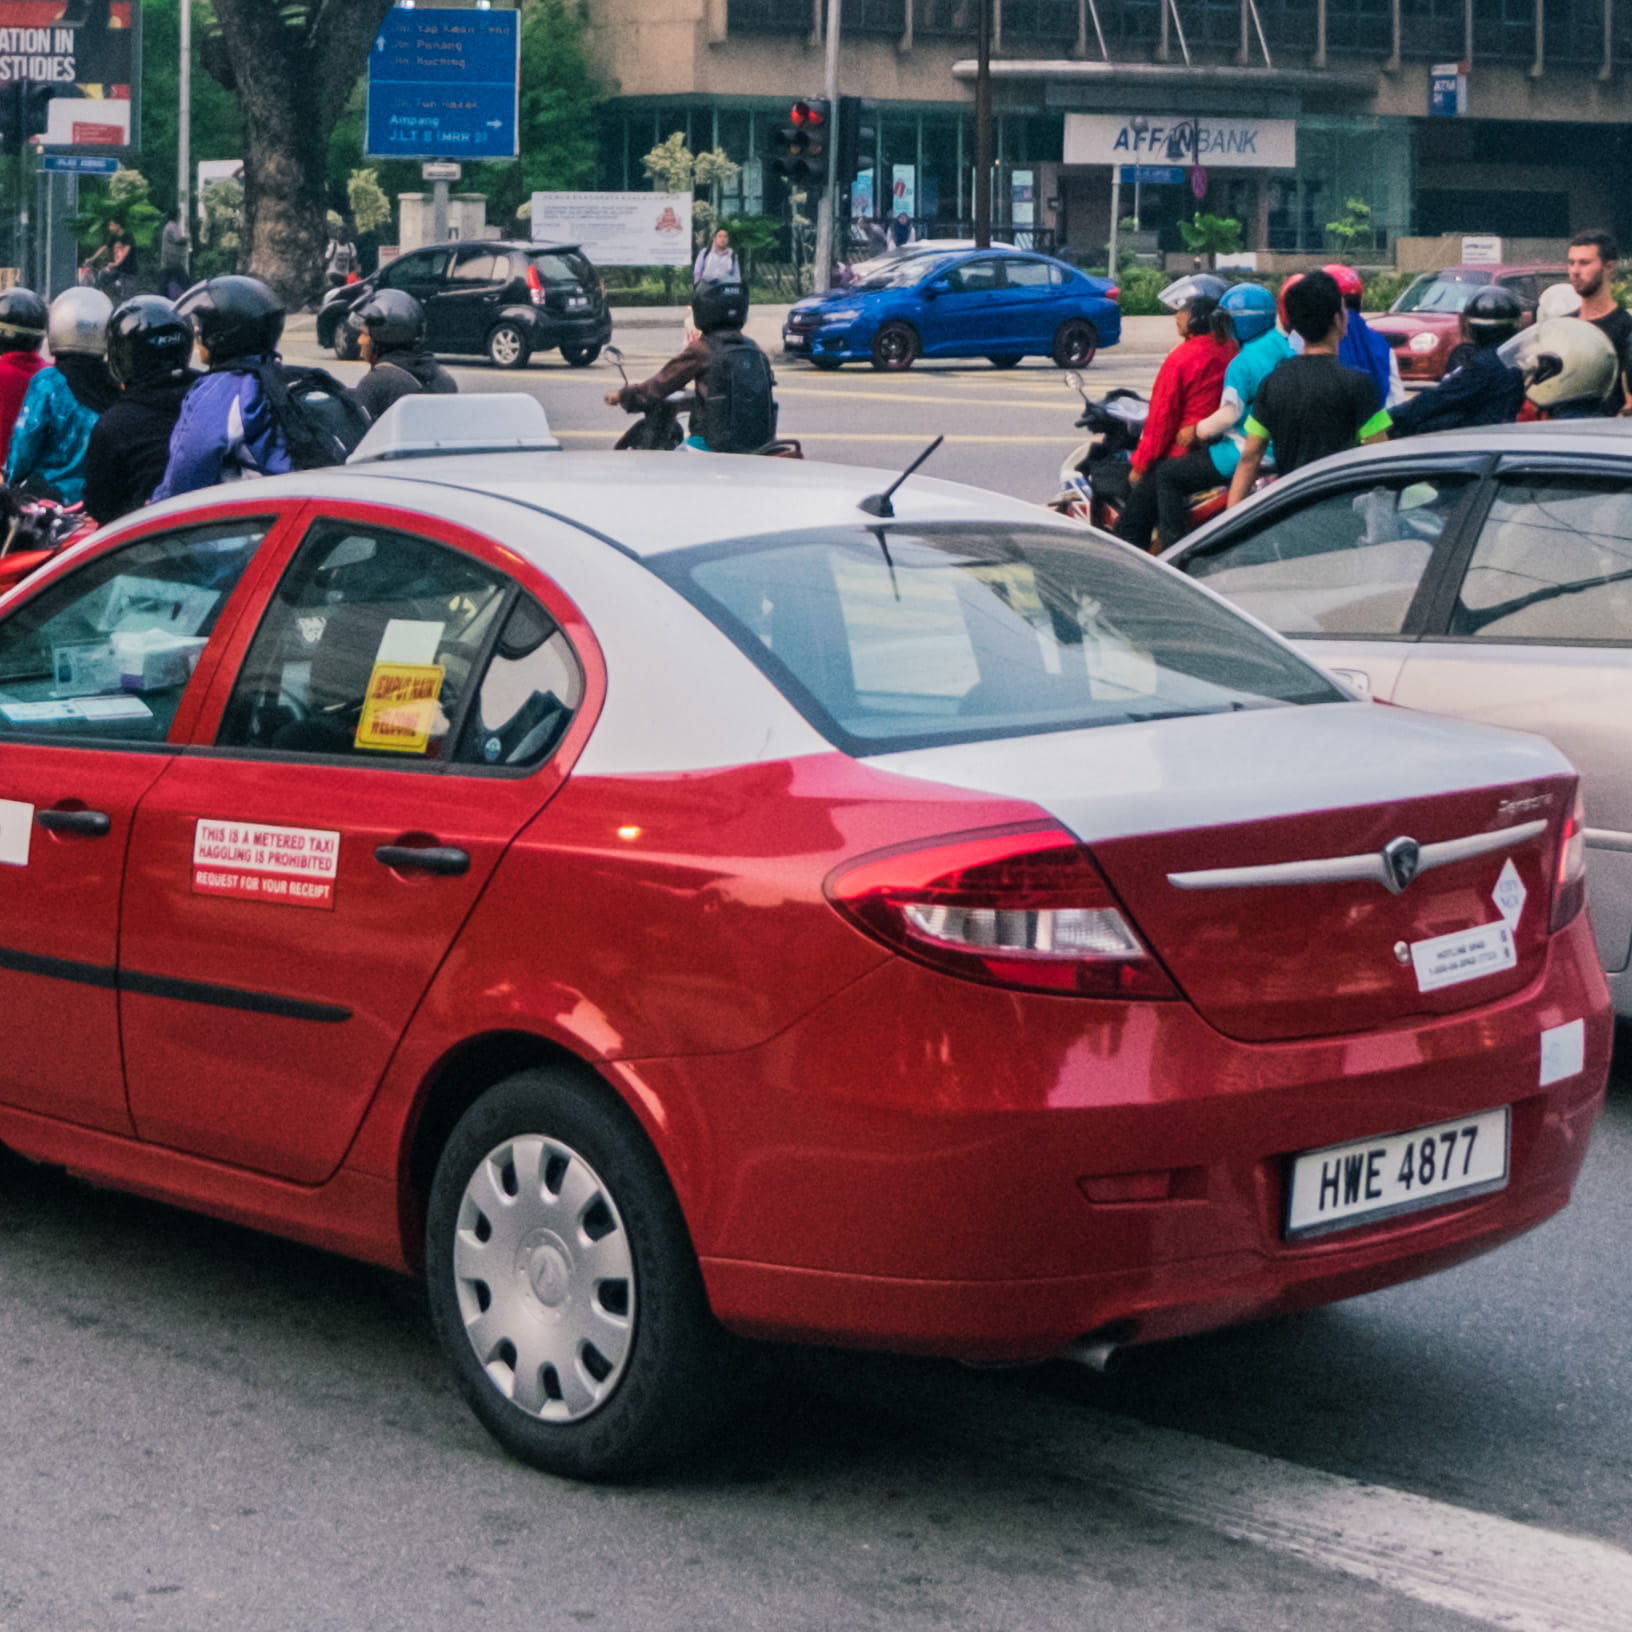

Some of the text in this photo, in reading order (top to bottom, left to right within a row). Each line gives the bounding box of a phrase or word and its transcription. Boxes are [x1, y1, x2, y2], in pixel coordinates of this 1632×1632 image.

[55, 27, 75, 54] IN
[389, 114, 440, 128] Ampang
[1196, 128, 1259, 154] BANK
[201, 826, 335, 853] THIS IS A METERED TAXI
[198, 844, 332, 872] HAGGLING IS PROHIBITED
[195, 870, 331, 899] REQUEST FOR YOUR RECEIPT
[1318, 1124, 1479, 1212] HWE 4877
